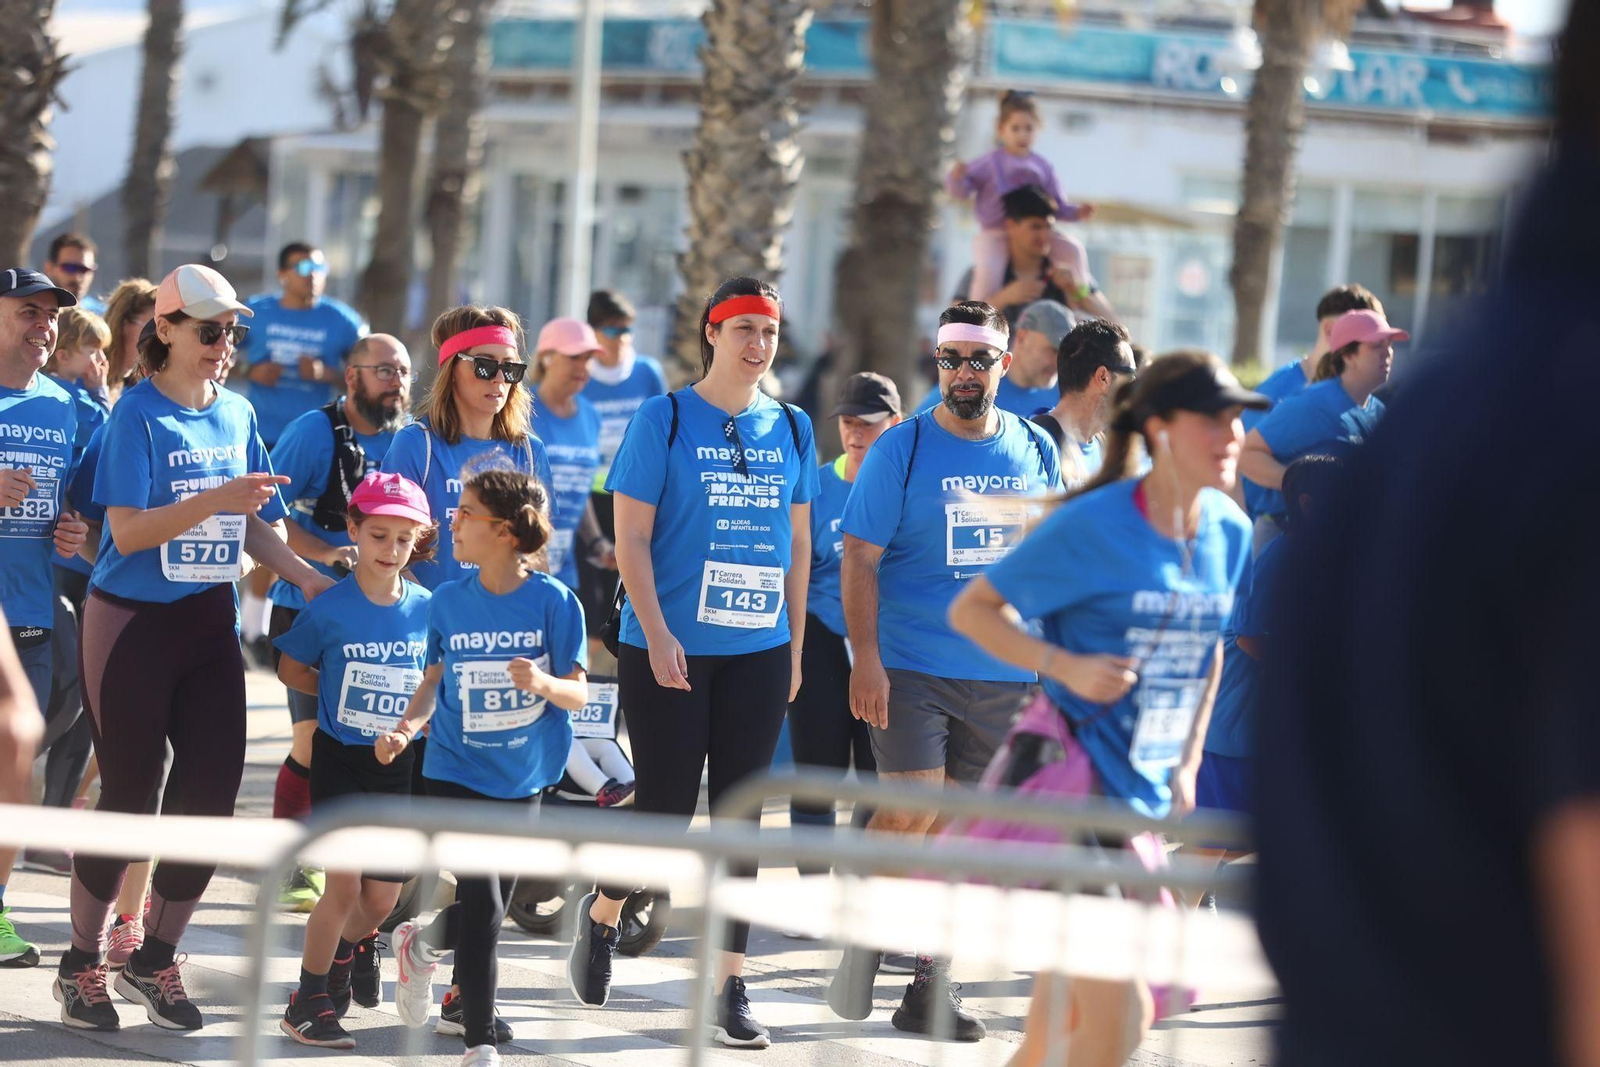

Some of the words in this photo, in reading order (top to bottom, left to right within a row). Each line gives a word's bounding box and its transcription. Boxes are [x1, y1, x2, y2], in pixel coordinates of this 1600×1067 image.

[696, 446, 784, 464] maoral
[171, 475, 238, 493] RUNNI
[701, 472, 787, 486] RUNNING
[941, 473, 1029, 494] mayoral
[710, 483, 780, 497] MAKES
[708, 495, 781, 508] FRIENDS
[219, 520, 242, 528] mayoral
[182, 528, 207, 537] olidaria
[973, 527, 1004, 547] 15
[181, 543, 230, 563] 570
[719, 570, 743, 579] Carrera
[758, 571, 781, 579] mayoral
[718, 576, 747, 586] Solidaria
[720, 589, 767, 611] 143
[703, 607, 717, 615] 5KM
[20, 629, 43, 638] adidas
[450, 629, 543, 654] mayoral
[361, 671, 386, 681] Carrera
[478, 670, 506, 678] Carrera
[360, 678, 390, 689] Solidaria
[478, 677, 511, 685] Solidaria
[362, 692, 410, 716] 100
[484, 690, 537, 711] 813
[343, 709, 357, 718] 5KM
